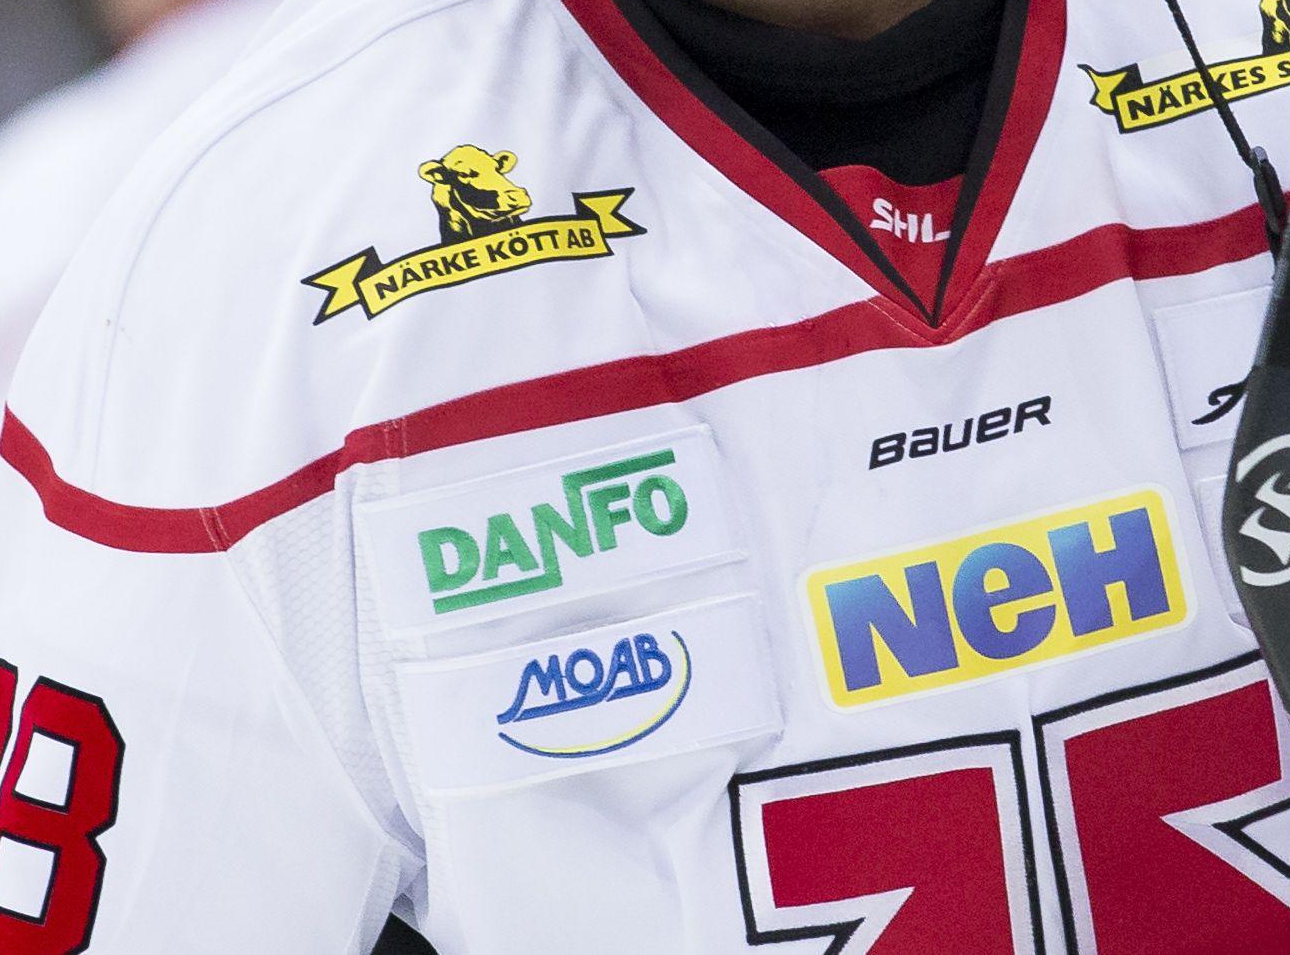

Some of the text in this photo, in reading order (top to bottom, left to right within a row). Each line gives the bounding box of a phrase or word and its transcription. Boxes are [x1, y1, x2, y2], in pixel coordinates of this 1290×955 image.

[870, 198, 951, 243] SHL
[375, 227, 595, 300] NÄRKE KÖTT AB
[418, 448, 688, 614] DANFO
[497, 632, 671, 724] MOAB
